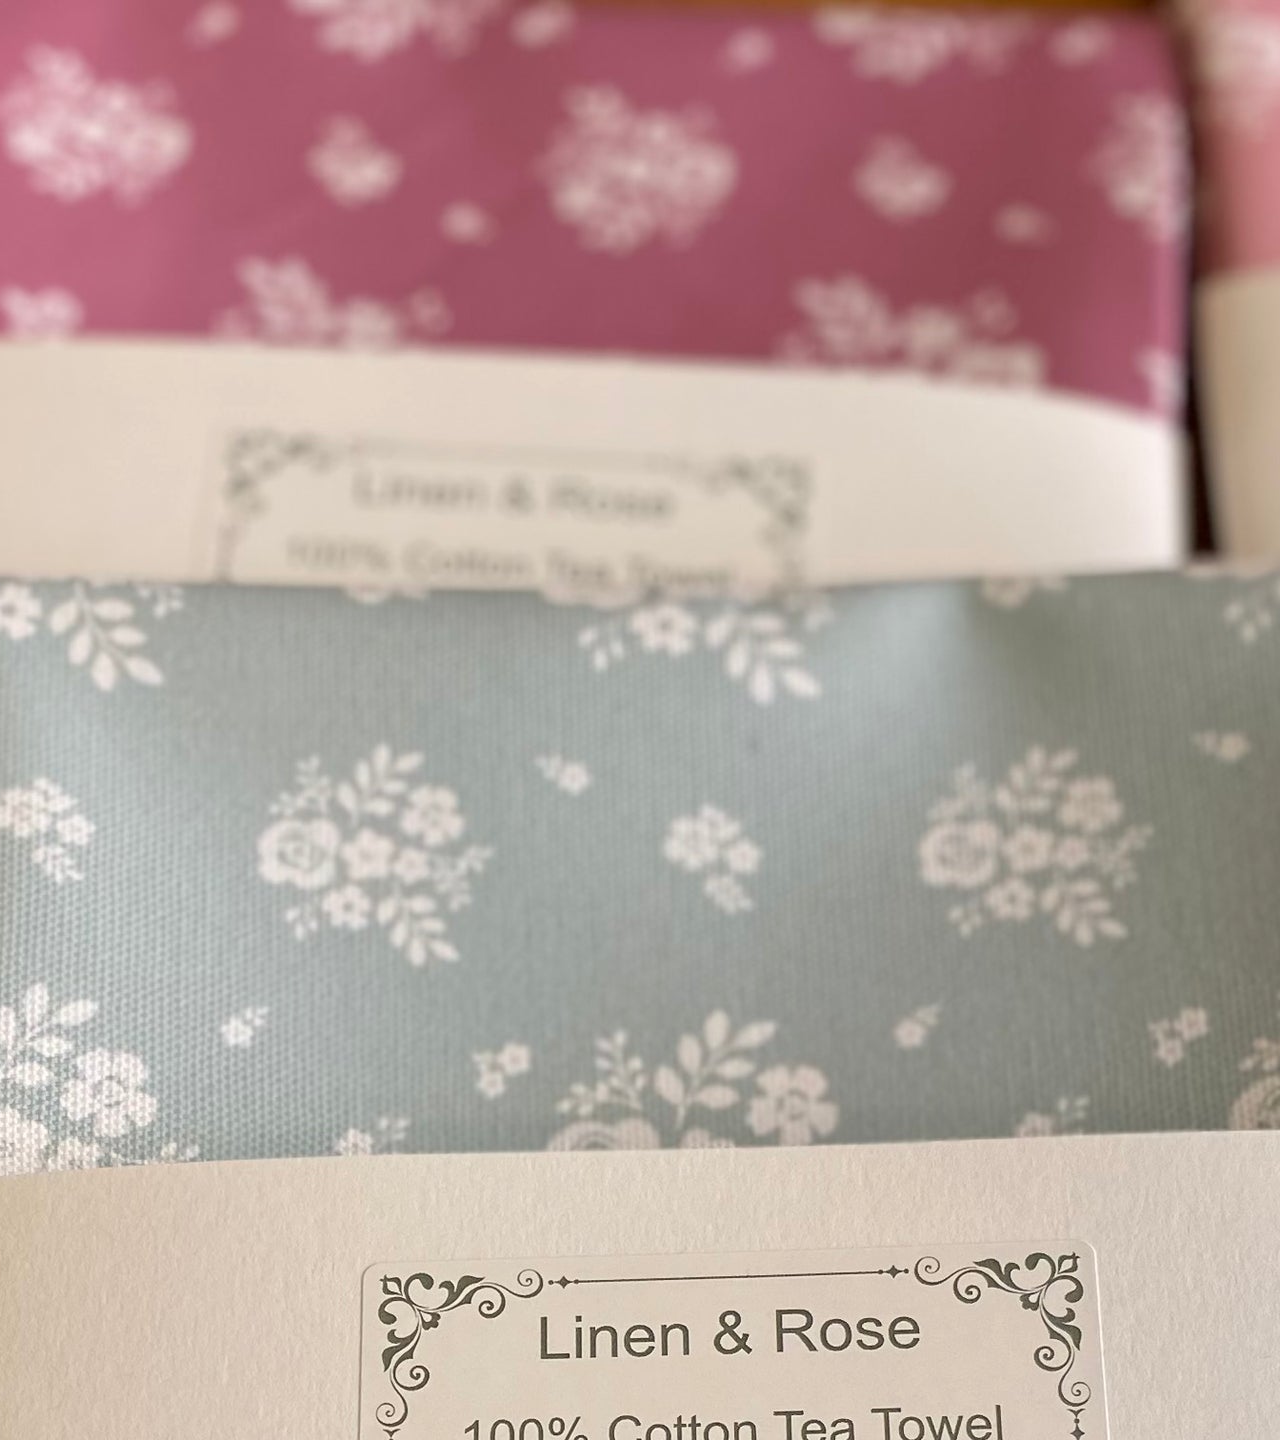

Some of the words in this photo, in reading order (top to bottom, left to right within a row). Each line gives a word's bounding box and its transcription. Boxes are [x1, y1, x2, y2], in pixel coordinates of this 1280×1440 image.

[539, 1314, 690, 1360] Linen
[712, 1309, 753, 1355] &
[774, 1307, 921, 1353] Rose
